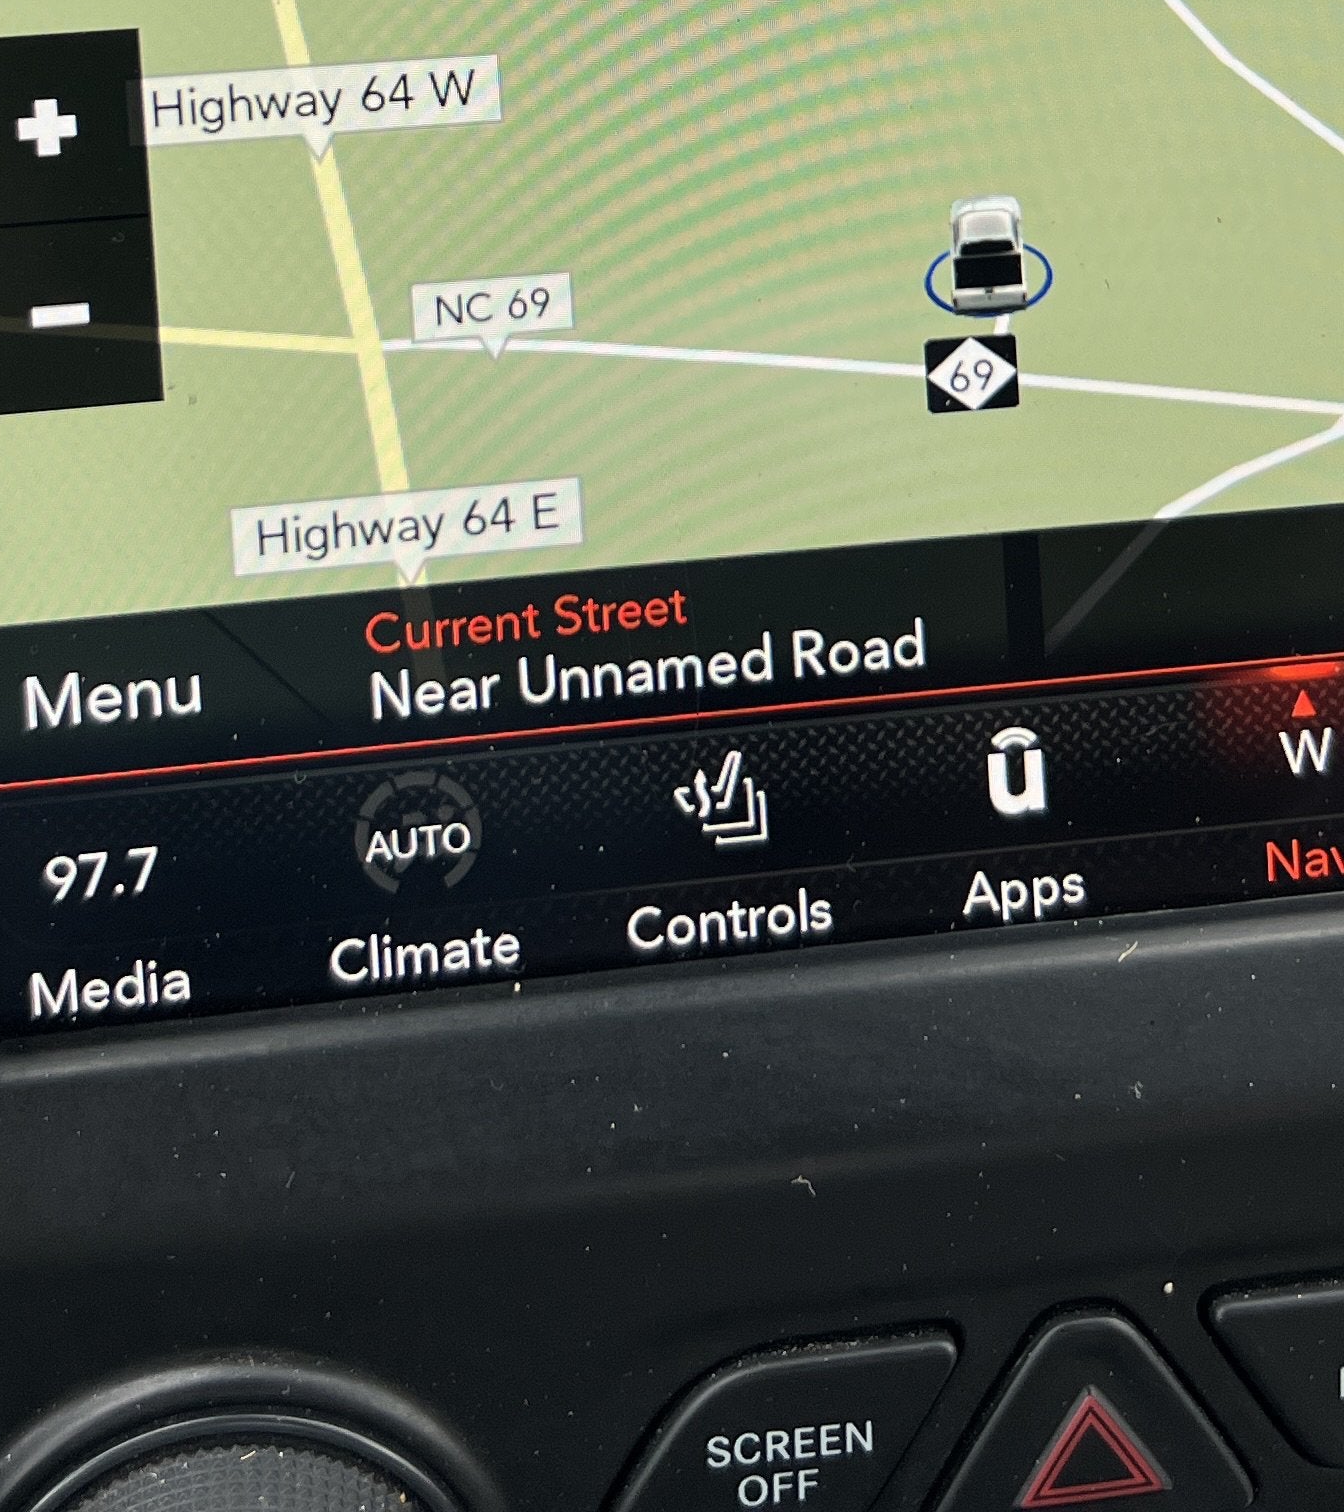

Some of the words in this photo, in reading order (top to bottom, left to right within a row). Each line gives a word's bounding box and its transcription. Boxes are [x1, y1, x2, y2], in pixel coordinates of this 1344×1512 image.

[152, 83, 342, 134] Highway
[361, 73, 414, 112] 64
[429, 69, 475, 107] W
[436, 292, 492, 326] NC
[508, 287, 550, 320] 69
[950, 359, 994, 392] 69
[257, 511, 444, 561] Highway
[463, 498, 515, 536] 64
[533, 493, 559, 530] E
[365, 603, 541, 654] Current
[554, 589, 688, 636] Street
[371, 668, 501, 720] Near
[517, 630, 773, 702] Unnamed
[792, 616, 926, 678] Road
[23, 671, 202, 730] Menu
[1278, 726, 1332, 775] W
[365, 822, 471, 863] AUTO
[44, 845, 158, 903] 97.7
[962, 870, 1085, 922] Apps
[627, 887, 833, 950] Controls
[329, 928, 520, 983] Climate
[29, 959, 191, 1017] Media
[707, 1420, 873, 1470] SCREEN
[738, 1468, 819, 1507] OFF
